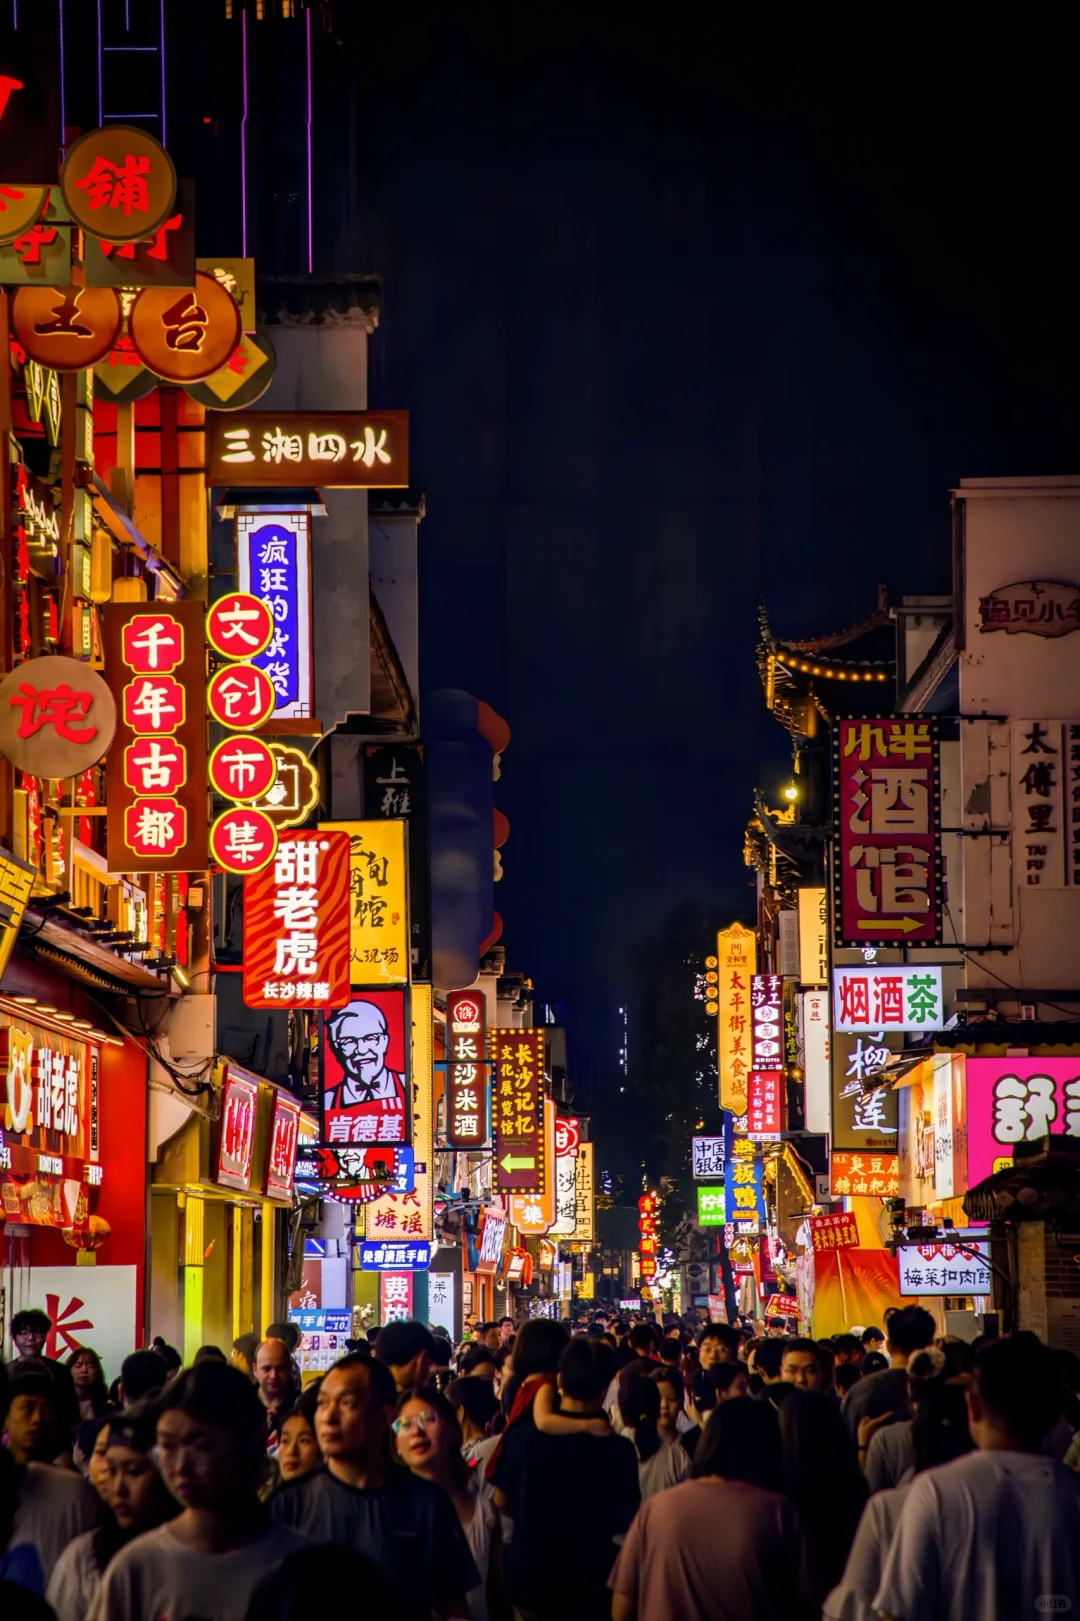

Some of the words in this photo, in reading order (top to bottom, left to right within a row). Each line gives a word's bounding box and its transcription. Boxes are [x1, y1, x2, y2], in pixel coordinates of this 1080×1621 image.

[221, 426, 393, 468] 三湘四水
[257, 536, 290, 697] 疯狂的杂货
[131, 622, 177, 849] 千年古都
[216, 601, 264, 864] 文创市集
[1019, 722, 1059, 834] 太傅里
[849, 767, 930, 914] 酒馆
[273, 840, 319, 976] 甜老虎
[262, 981, 330, 1000] 长沙辣酱
[728, 970, 749, 1098] 太平街美食城
[839, 973, 938, 1024] 烟酒茶
[454, 1037, 479, 1137] 长沙米酒
[500, 1045, 514, 1135] 文化展览馆
[514, 1043, 535, 1135] 长沙记忆
[752, 1075, 764, 1131] 手工粉面馆
[845, 1030, 898, 1134] 榴莲
[329, 1114, 404, 1143] 肯德基
[848, 1154, 899, 1176] 臭豆腐
[363, 1249, 427, 1263] 免费清洗手机
[813, 1223, 859, 1249] 老长沙臭豆腐
[45, 1293, 103, 1361] 长
